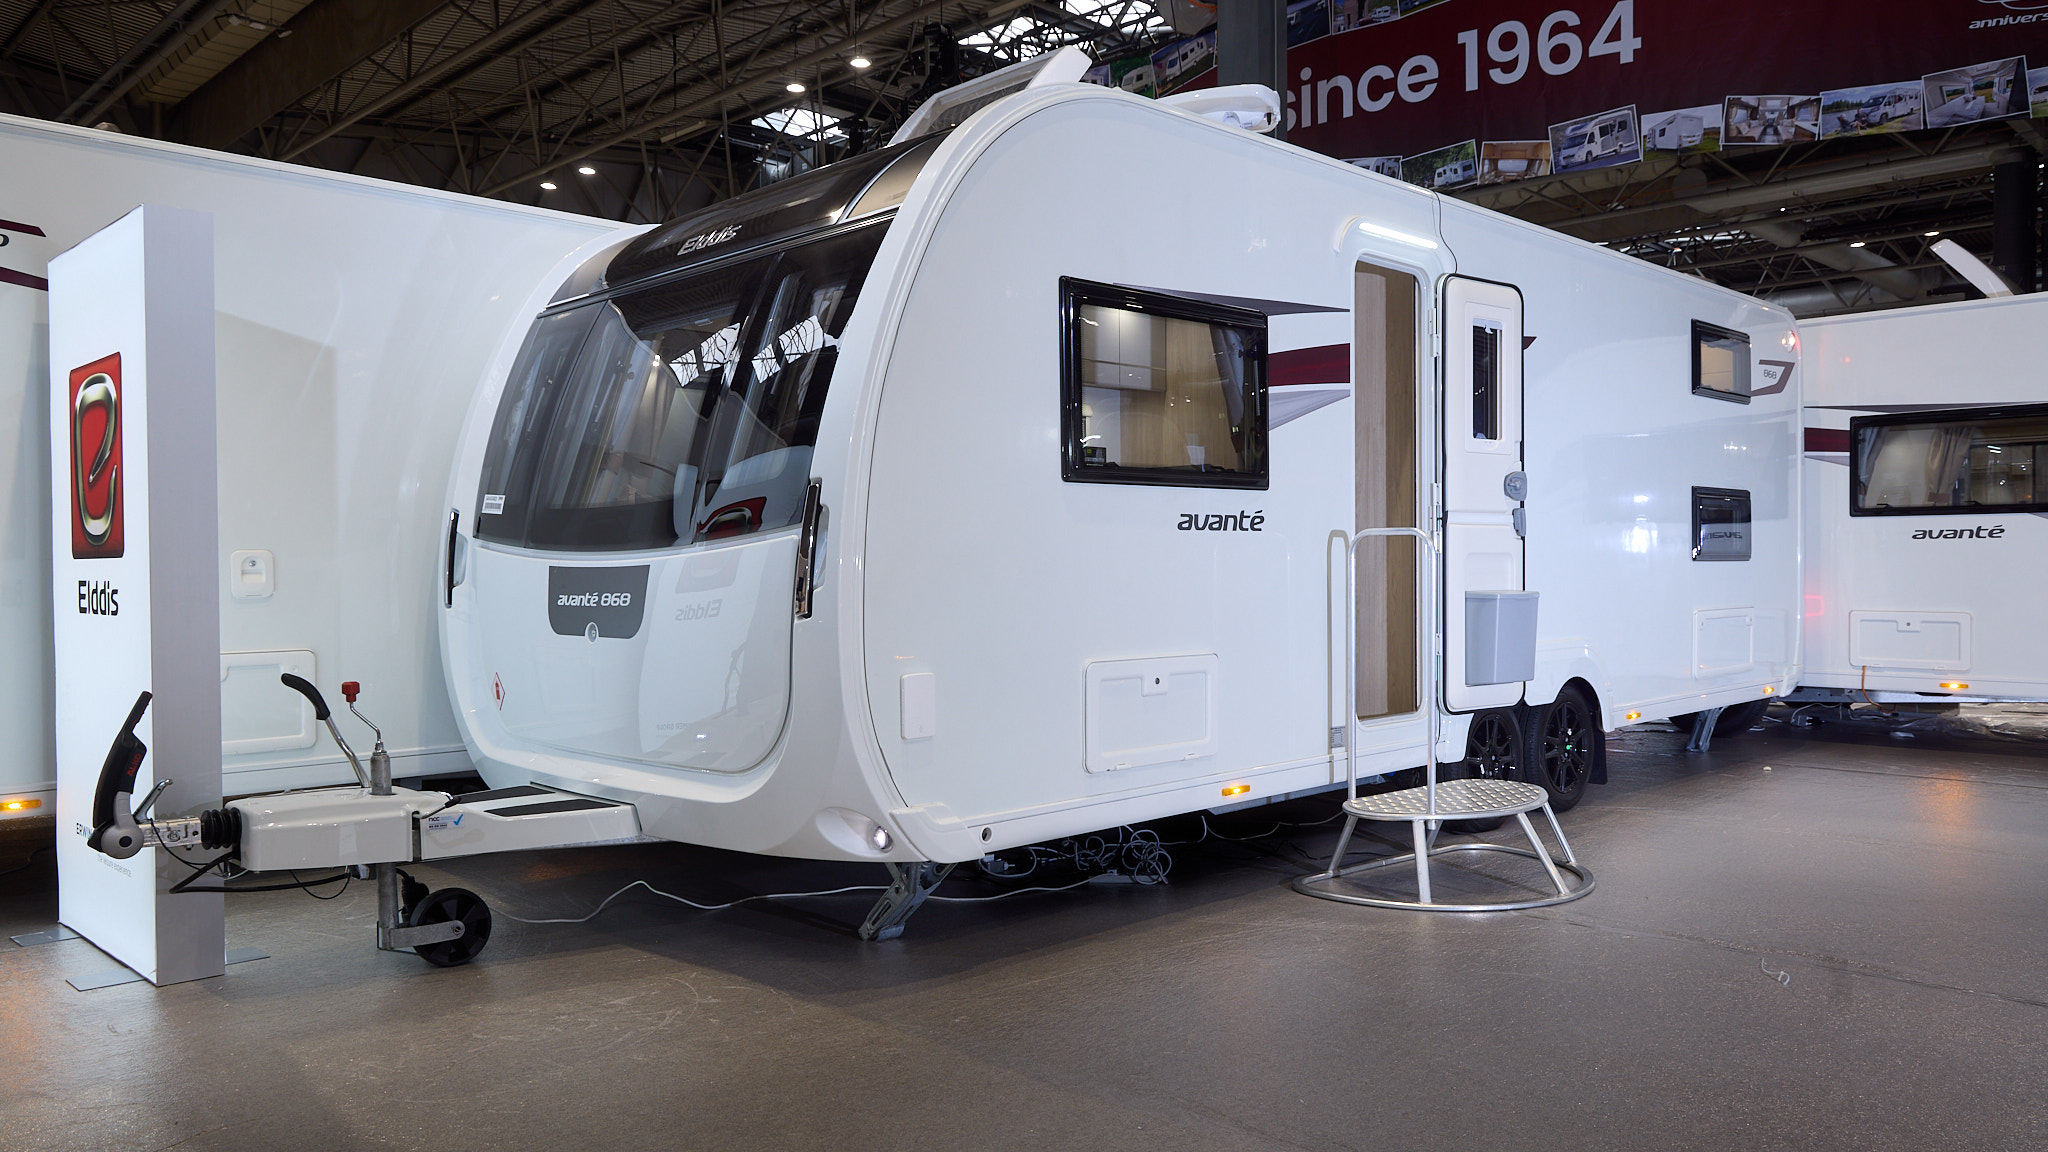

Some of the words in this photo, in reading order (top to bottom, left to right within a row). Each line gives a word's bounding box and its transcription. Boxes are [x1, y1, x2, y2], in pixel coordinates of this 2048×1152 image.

[1287, 54, 1440, 132] ince
[1457, 0, 1642, 93] 1964
[676, 224, 743, 256] Elddis
[1177, 509, 1265, 532] avanté
[1911, 524, 2006, 540] avanté
[78, 580, 119, 617] Elddis
[557, 592, 599, 607] avanté
[600, 592, 632, 607] 868
